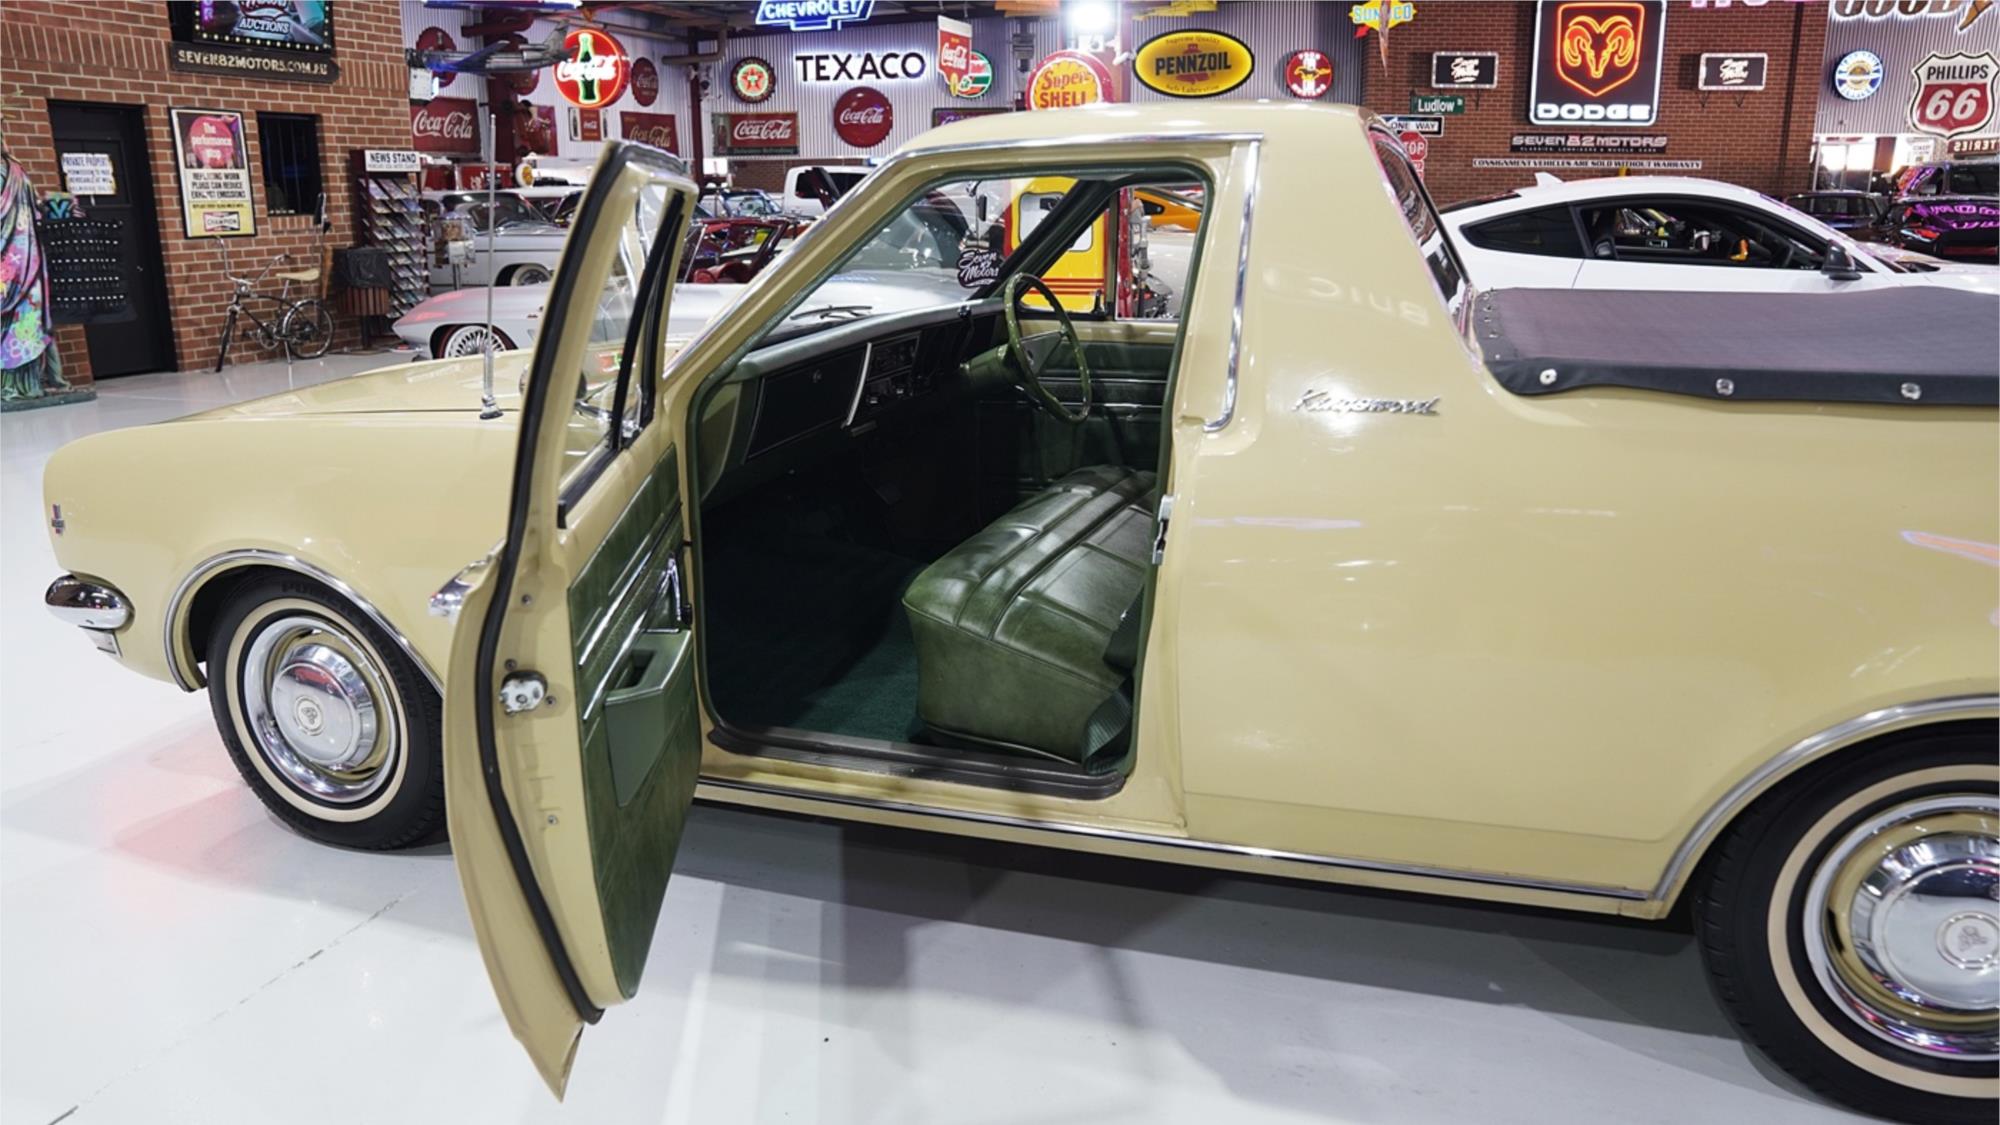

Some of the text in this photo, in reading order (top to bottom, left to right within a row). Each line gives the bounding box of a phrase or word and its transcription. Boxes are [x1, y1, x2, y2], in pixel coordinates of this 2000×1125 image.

[764, 0, 861, 18] CHEVROLET
[1354, 4, 1412, 21] SUNCO
[239, 19, 290, 34] AUCTIONS
[178, 50, 328, 75] SEVEN82MOTORS.COM.AU
[796, 52, 926, 82] TEXACO
[1155, 52, 1232, 76] PENNZOIL
[1927, 64, 1989, 81] PHILLIPS
[1418, 98, 1455, 112] Ludlow
[1537, 104, 1650, 120] DODGE
[1925, 88, 1982, 121] 66
[413, 109, 474, 138] Coca-Cola
[840, 106, 885, 125] Coca-Cola
[734, 120, 793, 140] Coca-Cola
[1391, 121, 1436, 130] ONE WAY
[370, 152, 416, 164] NEWS STAND
